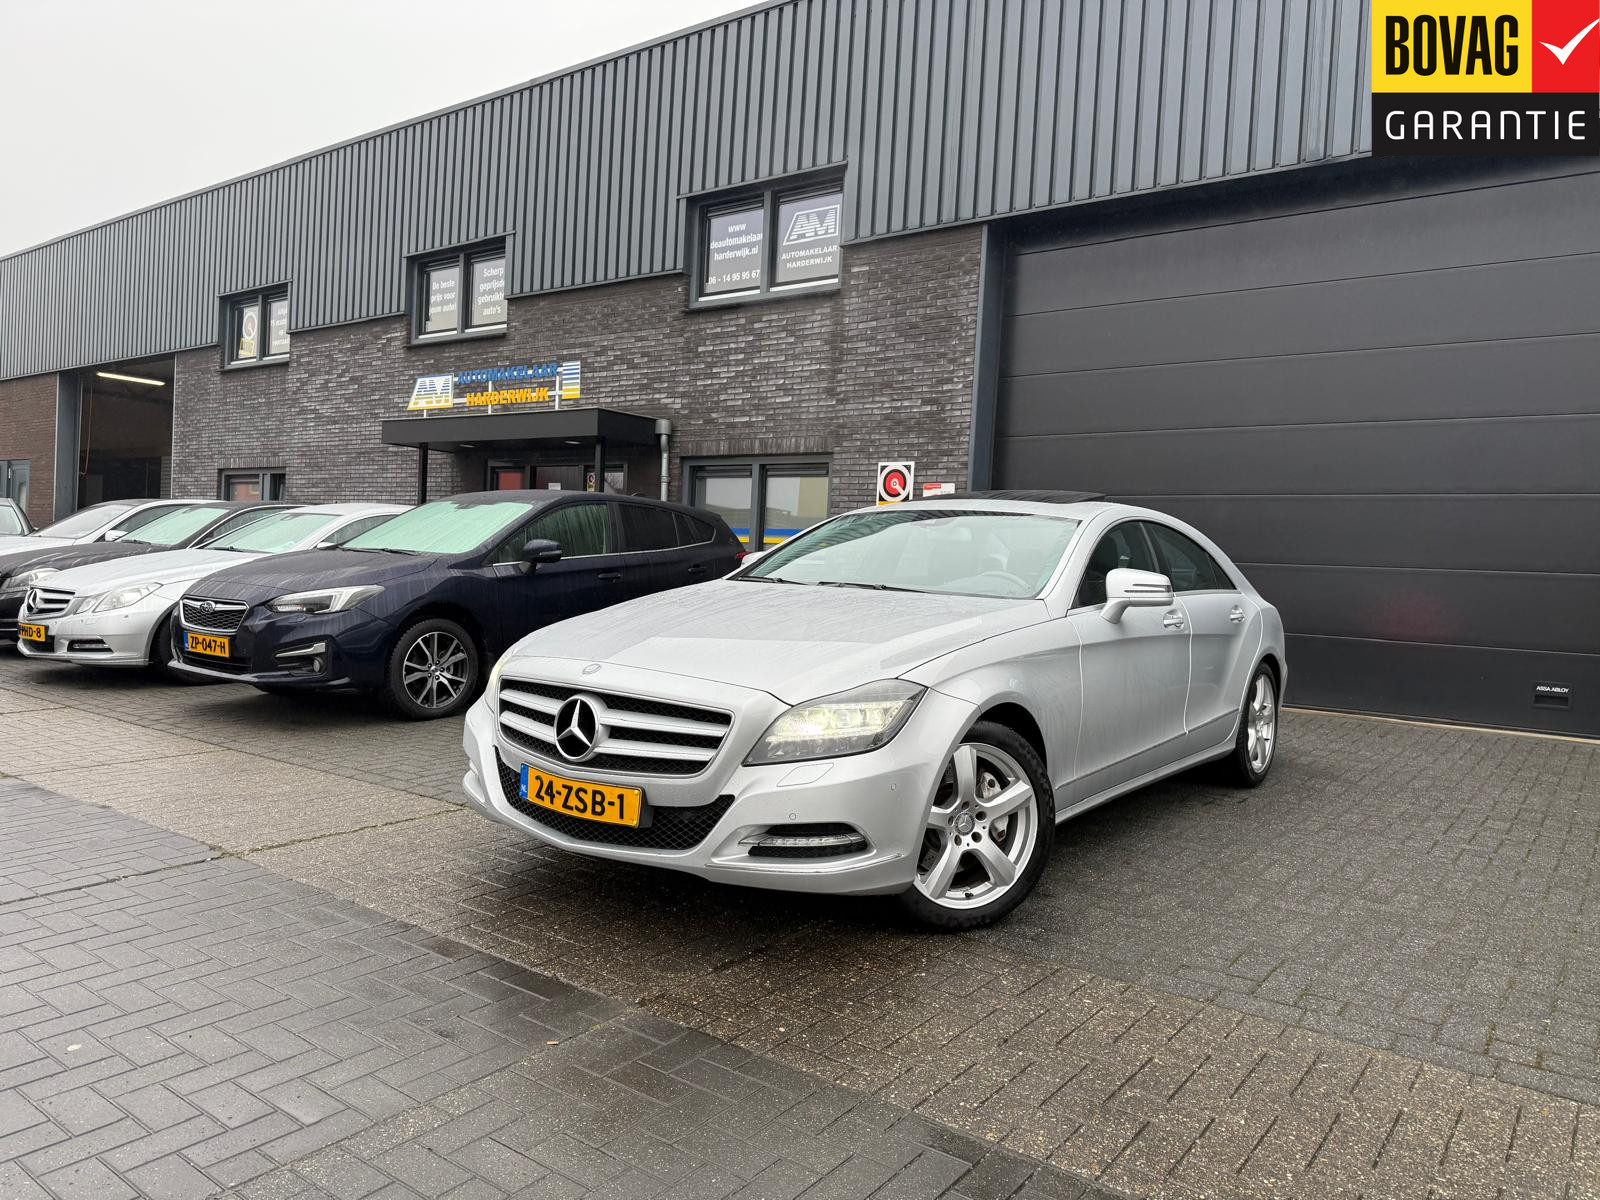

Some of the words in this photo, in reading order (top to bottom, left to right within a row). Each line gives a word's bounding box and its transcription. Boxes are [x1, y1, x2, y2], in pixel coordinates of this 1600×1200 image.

[728, 223, 747, 233] www
[714, 245, 759, 261] harderwijk.nl
[781, 245, 838, 260] AUTOMAKELAAR
[786, 256, 833, 269] HARDERWIJK
[483, 267, 504, 277] Scherp
[723, 274, 731, 283] 14
[440, 279, 455, 289] beste
[457, 363, 558, 385] AUTOMAKELAAR
[466, 387, 550, 407] HARDERWIJK
[190, 635, 226, 654] ZP-047-H
[534, 774, 625, 820] 24-ZSB-1
